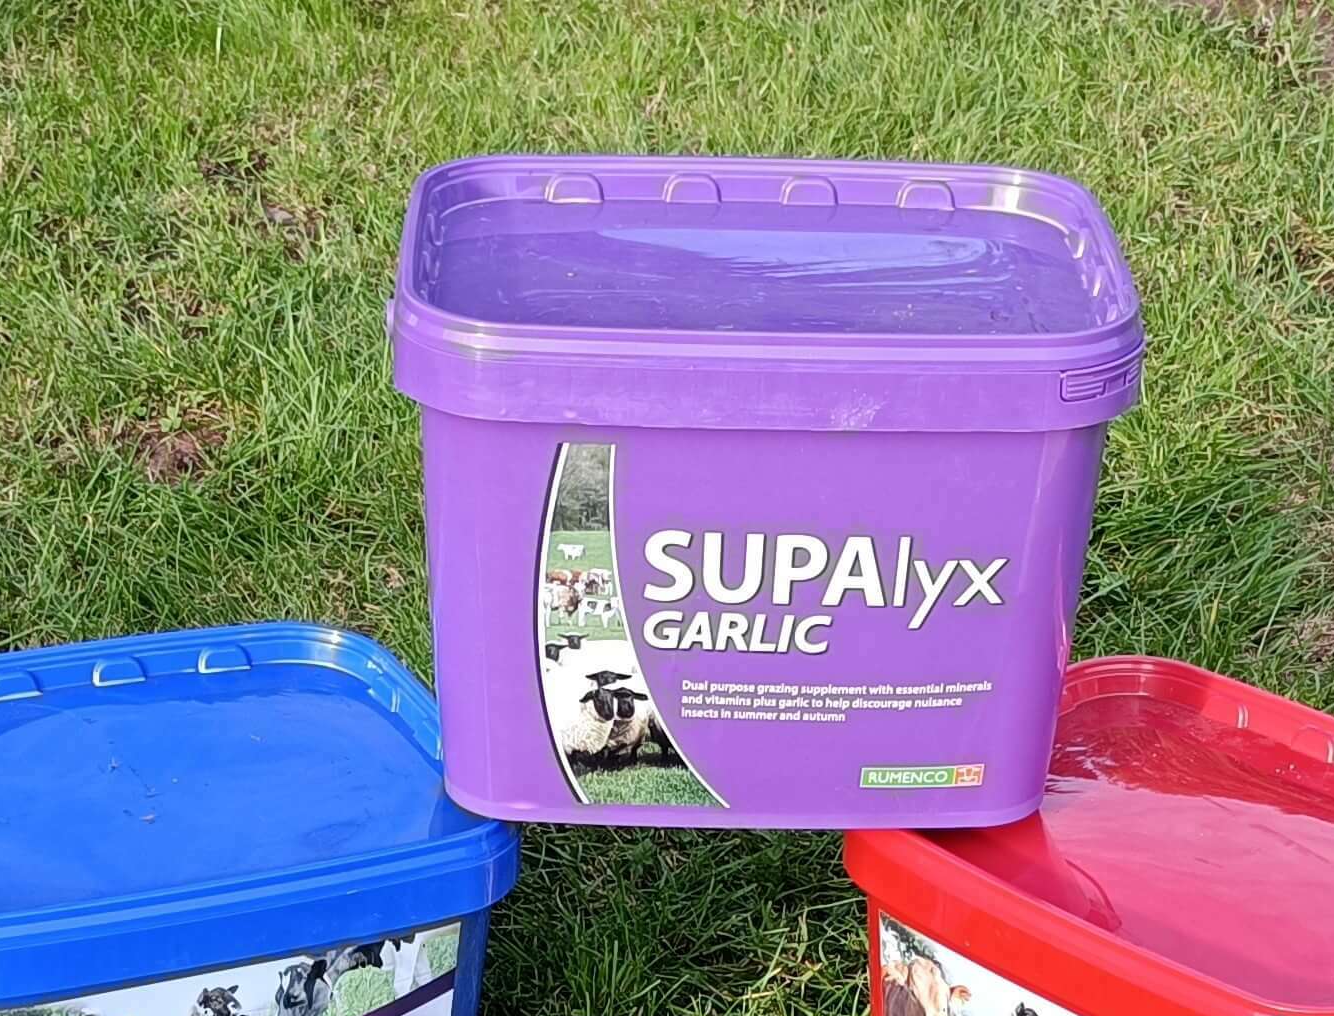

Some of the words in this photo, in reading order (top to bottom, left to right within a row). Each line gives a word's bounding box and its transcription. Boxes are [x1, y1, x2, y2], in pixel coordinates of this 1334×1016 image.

[642, 529, 1008, 630] SUPAlyx
[641, 611, 833, 655] GARLIC
[682, 680, 708, 691] Dual
[710, 682, 755, 695] purpose
[757, 682, 798, 696] grazing
[801, 682, 866, 697] supplement
[869, 683, 894, 695] with
[896, 682, 943, 695] essential
[946, 680, 992, 692] minerals
[681, 694, 703, 705] and
[705, 694, 751, 707] vitamins
[753, 696, 776, 710] plus
[778, 696, 810, 710] garlic
[812, 697, 823, 708] to
[825, 697, 850, 711] help
[852, 697, 912, 710] discourage
[914, 695, 963, 707] nuisance
[681, 707, 719, 719] insects
[720, 708, 731, 719] in
[733, 709, 777, 721] summer
[779, 709, 801, 721] and
[802, 710, 846, 722] autumn
[867, 770, 948, 785] RUMENCO
